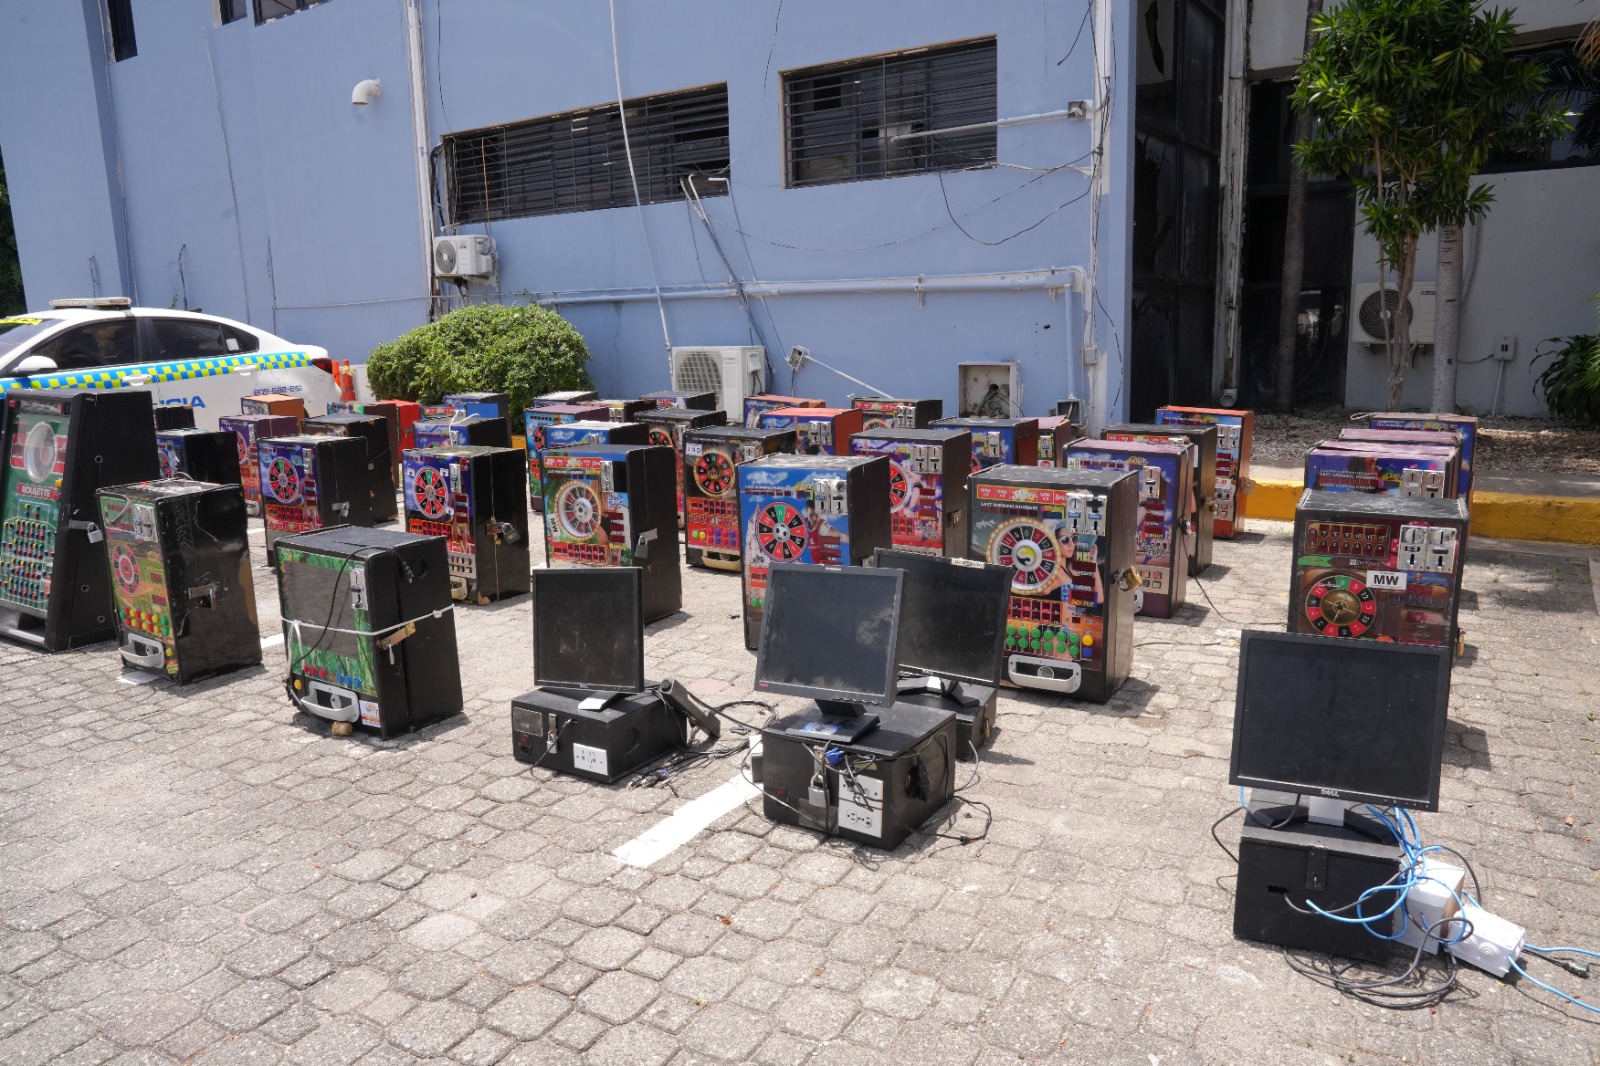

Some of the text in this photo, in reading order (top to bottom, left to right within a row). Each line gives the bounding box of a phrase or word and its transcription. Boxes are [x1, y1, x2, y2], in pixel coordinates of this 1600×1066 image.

[22, 485, 50, 497] ROULETTE
[550, 517, 558, 533] MW
[1374, 575, 1399, 585] MW
[1321, 789, 1339, 797] DELL
